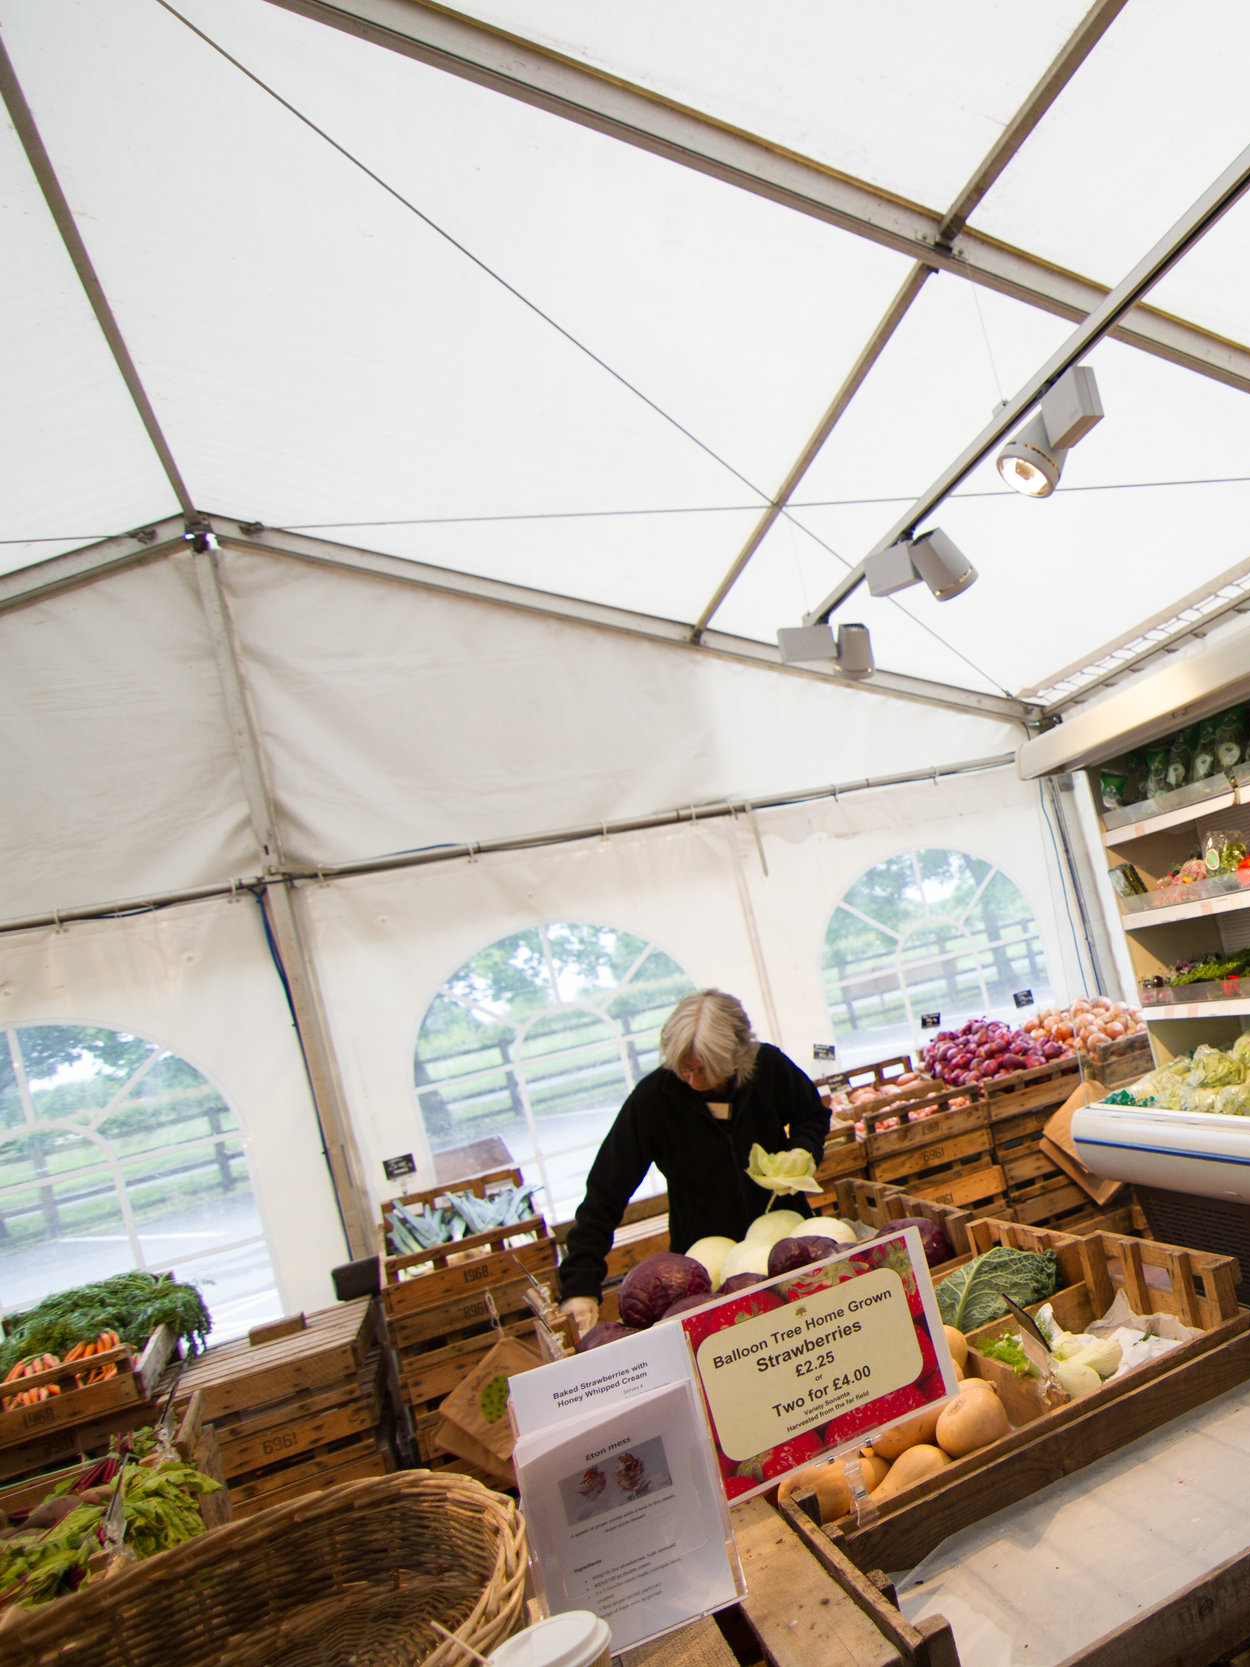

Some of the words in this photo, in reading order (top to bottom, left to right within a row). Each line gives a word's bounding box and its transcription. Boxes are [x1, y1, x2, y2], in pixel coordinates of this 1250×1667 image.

[712, 1338, 768, 1370] Balloon
[770, 1327, 802, 1346] Tree
[805, 1307, 845, 1331] Home
[848, 1289, 892, 1314] Grown
[756, 1321, 862, 1373] Strawberries
[553, 1386, 579, 1400] Baked
[580, 1368, 630, 1390] Strawberries
[631, 1361, 648, 1372] with
[795, 1351, 835, 1378] £2.25
[814, 1373, 823, 1381] or
[557, 1395, 584, 1408] Honey
[585, 1381, 620, 1398] Whipped
[622, 1371, 648, 1385] Cream
[772, 1398, 805, 1418] Two
[807, 1384, 830, 1404] for
[832, 1365, 871, 1391] £4.00
[786, 1414, 819, 1433] Harvested
[819, 1407, 835, 1419] from
[834, 1402, 845, 1412] the
[845, 1397, 855, 1408] far
[855, 1390, 869, 1402] field
[803, 1403, 825, 1416] Variety
[585, 1447, 606, 1462] Eton
[608, 1437, 631, 1451] mess
